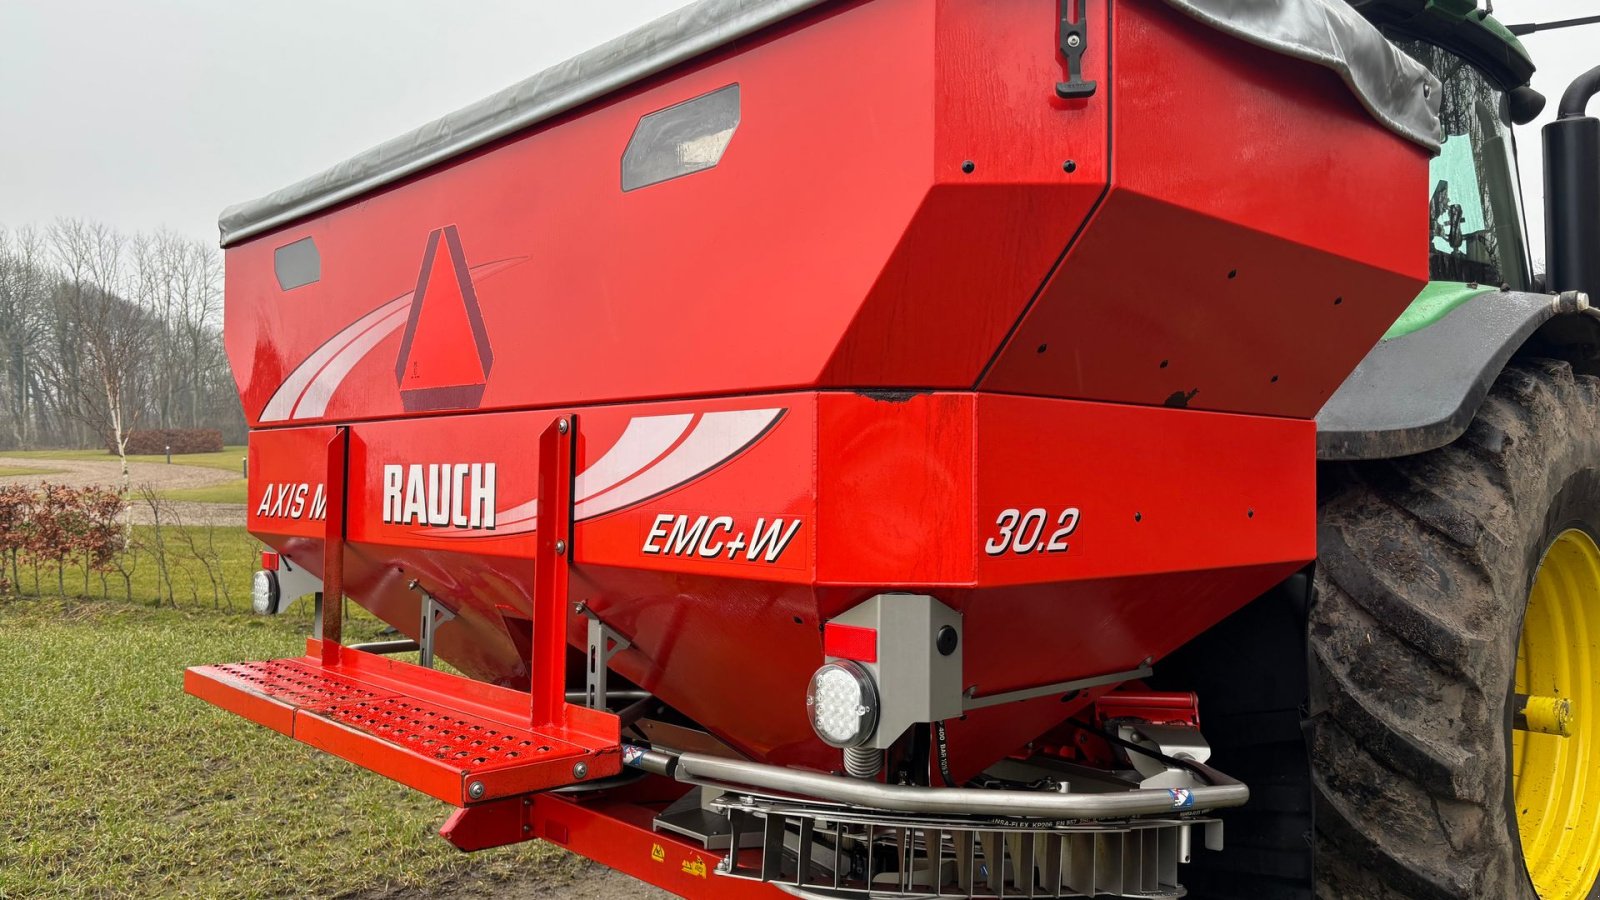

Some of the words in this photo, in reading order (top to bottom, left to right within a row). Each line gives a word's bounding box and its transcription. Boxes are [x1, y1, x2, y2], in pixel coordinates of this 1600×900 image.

[256, 483, 309, 520] AXIS
[383, 462, 497, 531] RAUCH
[642, 513, 802, 564] EMC+W
[984, 507, 1081, 557] 30.2
